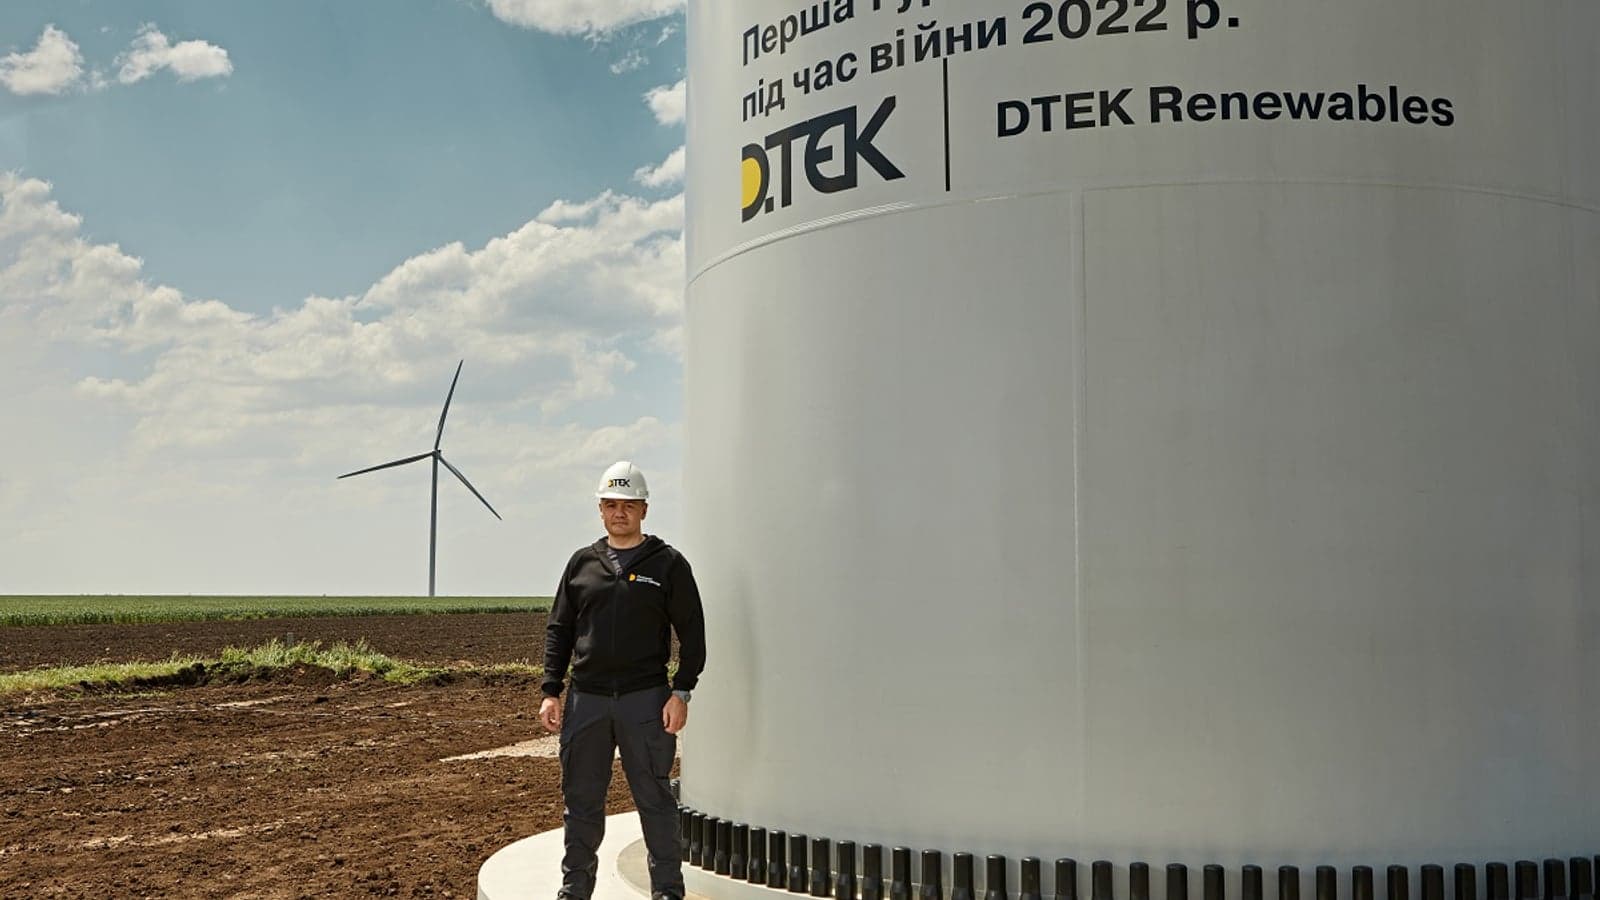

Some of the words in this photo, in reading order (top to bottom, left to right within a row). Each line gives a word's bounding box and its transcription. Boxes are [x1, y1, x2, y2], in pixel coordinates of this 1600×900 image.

[742, 78, 785, 122] під
[793, 52, 858, 95] час
[1021, 0, 1168, 45] 2022
[743, 0, 855, 66] Перша
[997, 87, 1136, 138] DTEK
[1149, 83, 1456, 127] Renewables
